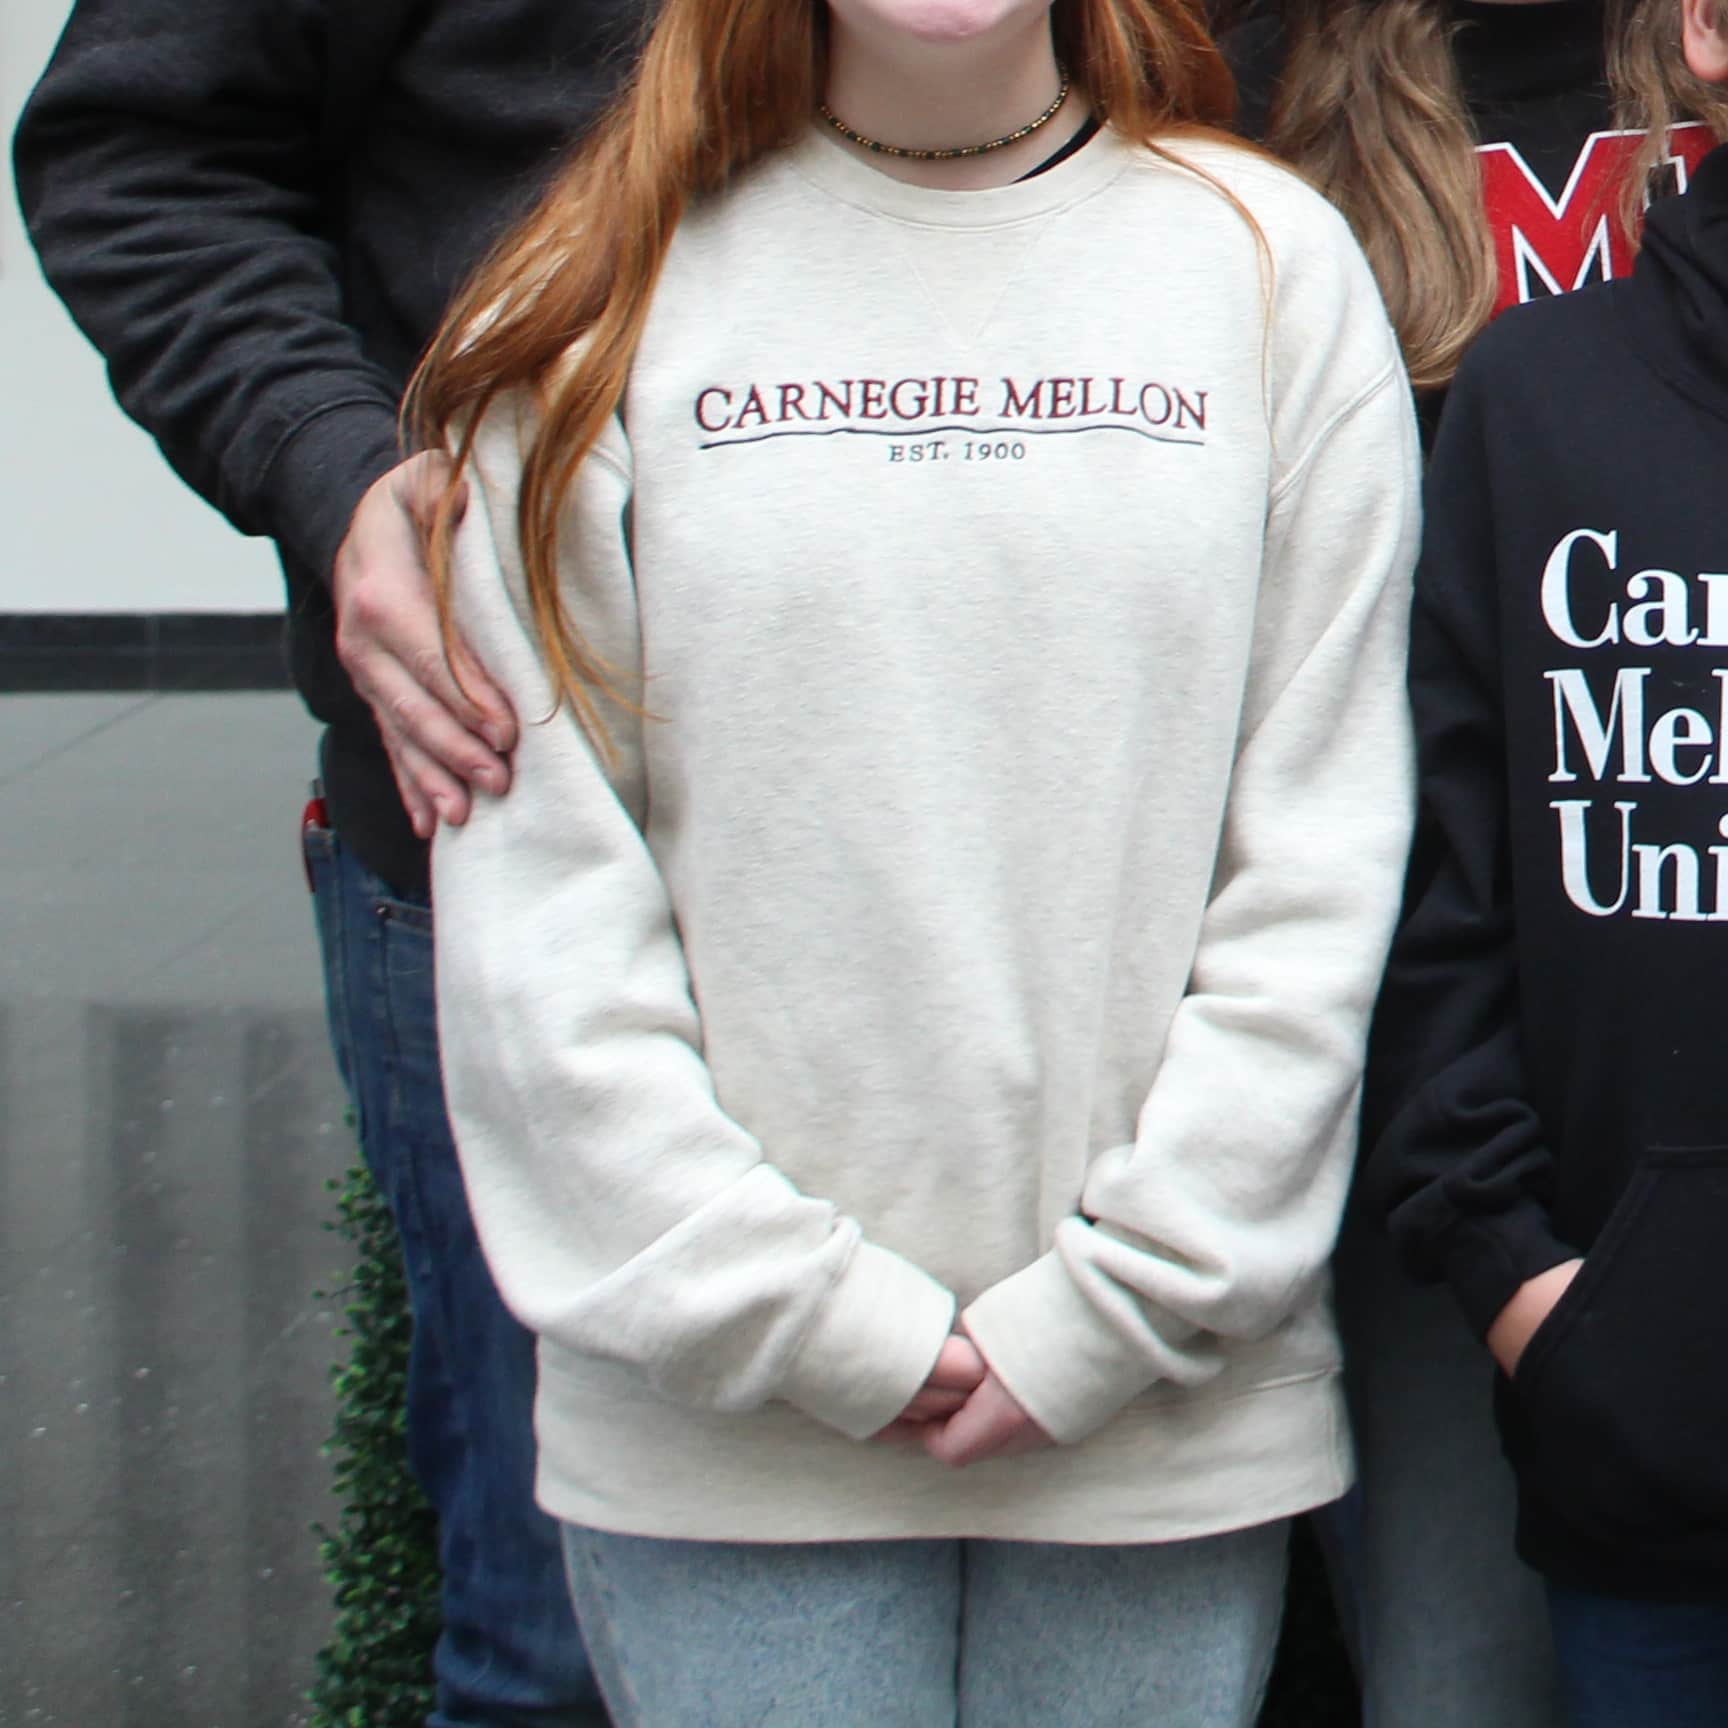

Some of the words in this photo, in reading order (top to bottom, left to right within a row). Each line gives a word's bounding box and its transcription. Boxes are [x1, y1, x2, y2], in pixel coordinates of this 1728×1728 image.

[694, 376, 980, 432] CARNEGIE
[999, 376, 1208, 431] MELLON
[888, 441, 949, 463] EST.
[963, 439, 1026, 462] 1900
